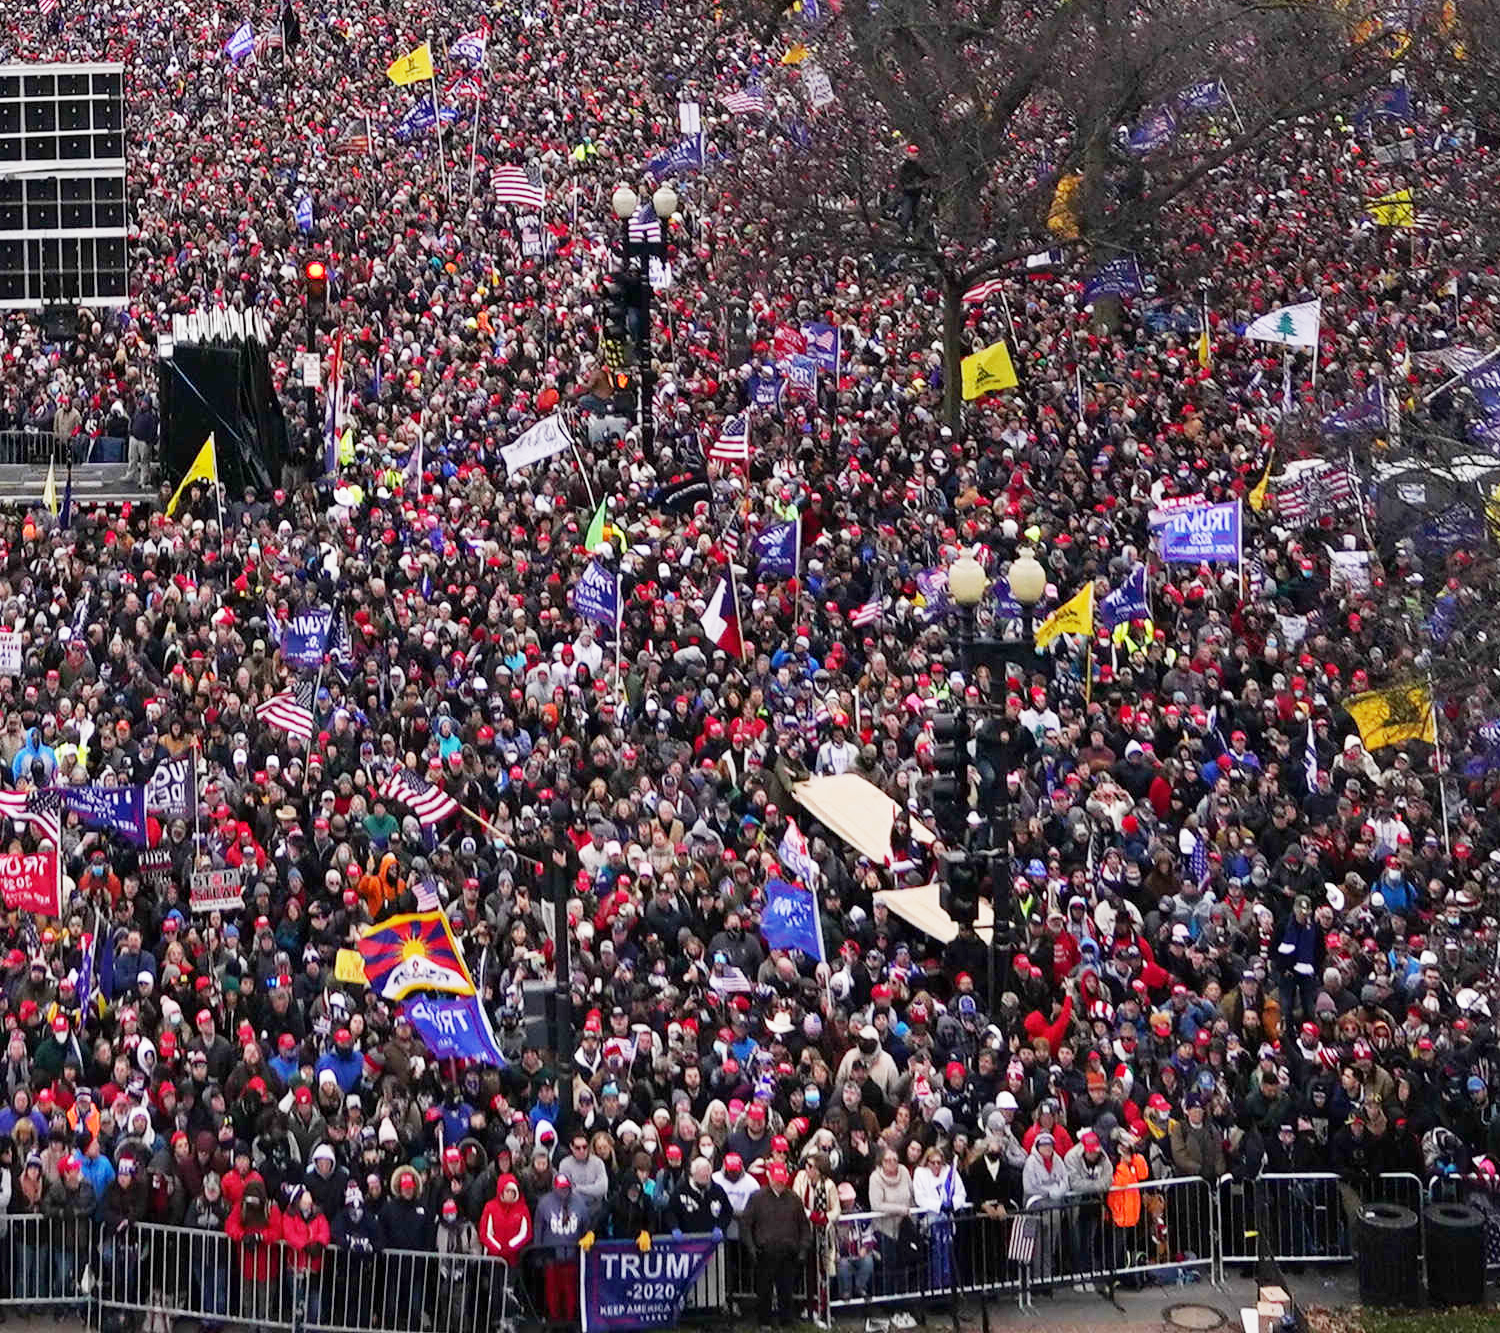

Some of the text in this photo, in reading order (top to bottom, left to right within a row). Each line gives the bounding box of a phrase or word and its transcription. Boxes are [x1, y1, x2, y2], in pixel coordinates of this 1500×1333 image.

[192, 871, 236, 887] STOP
[600, 1303, 671, 1317] KEEP AMERICA
